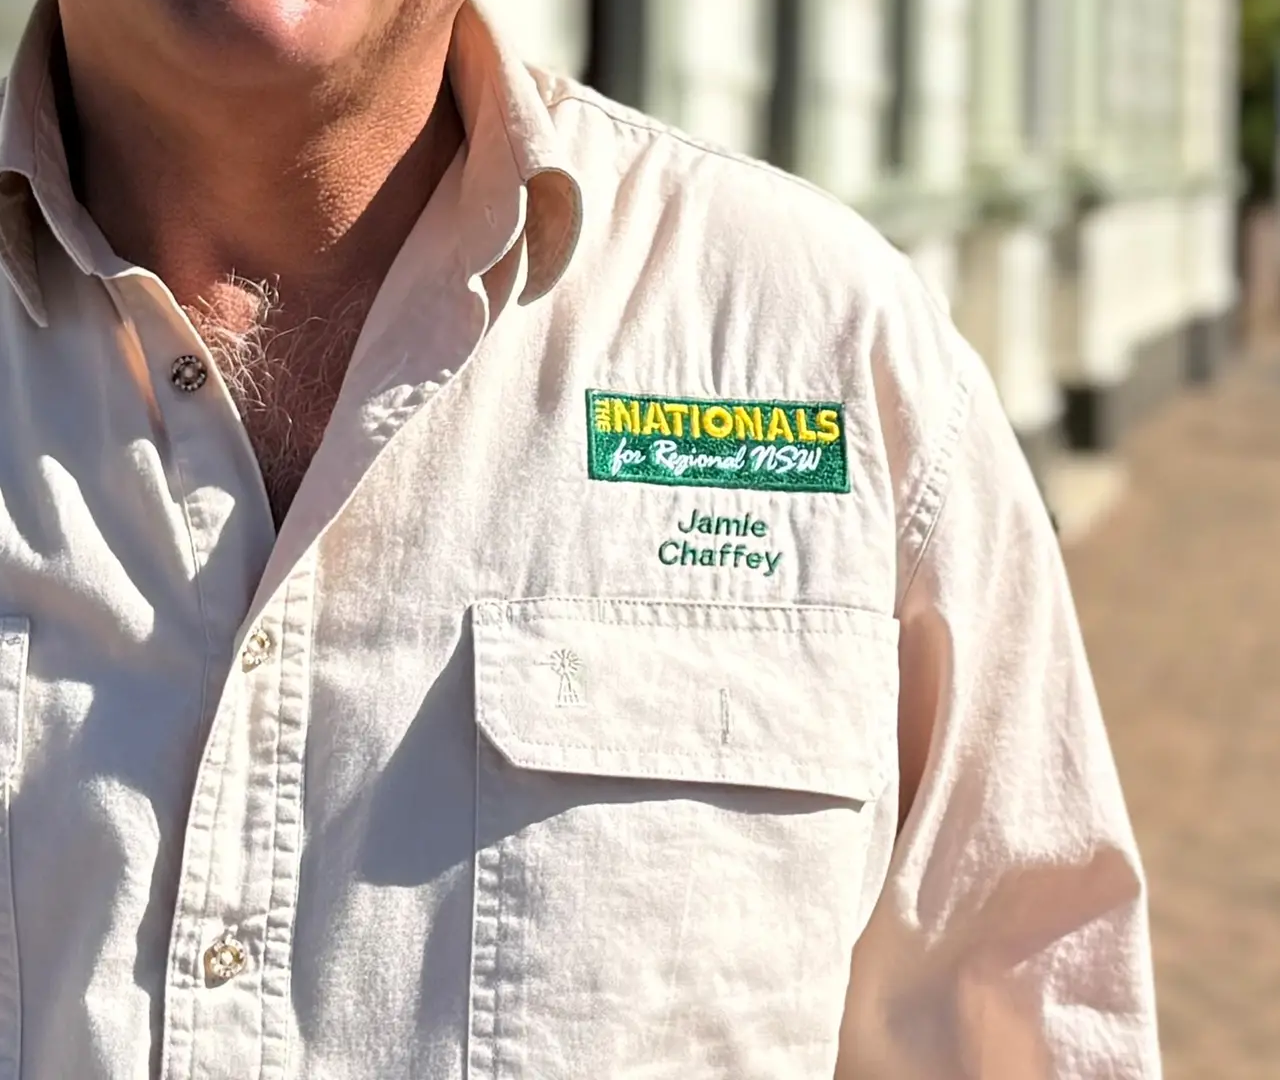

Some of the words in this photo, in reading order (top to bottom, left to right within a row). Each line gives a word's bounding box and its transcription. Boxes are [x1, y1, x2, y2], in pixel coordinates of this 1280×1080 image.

[595, 399, 611, 432] THE
[613, 399, 841, 442] NATIONALS
[612, 438, 646, 475] for
[652, 440, 745, 475] Regional
[750, 445, 822, 473] NSW
[678, 509, 768, 538] Jamie
[658, 540, 782, 576] Chaffey
